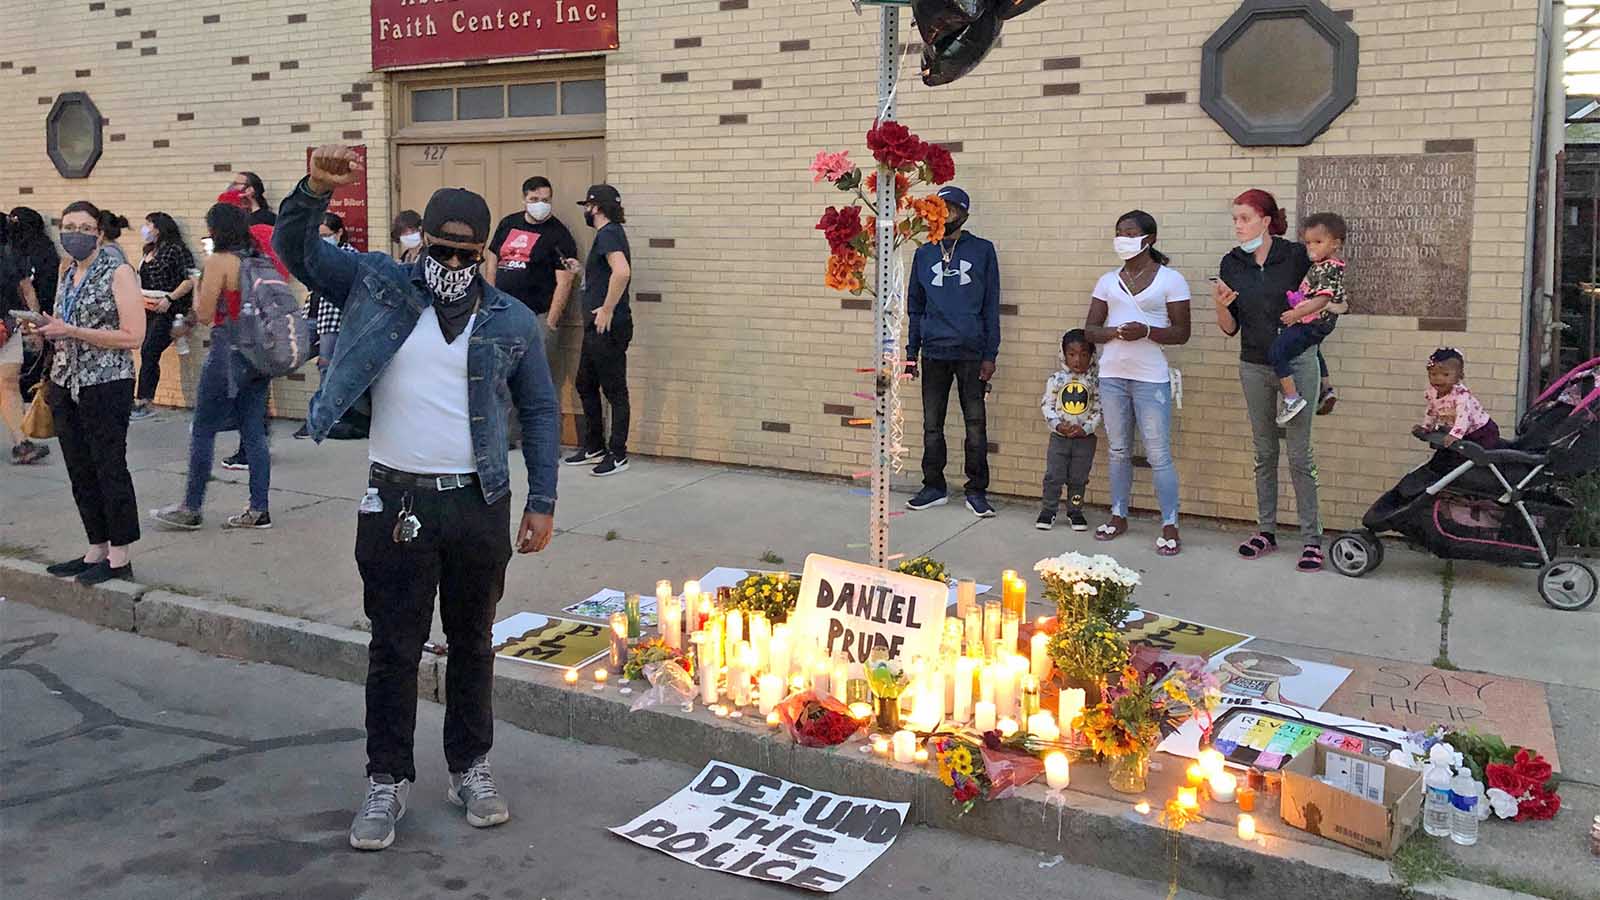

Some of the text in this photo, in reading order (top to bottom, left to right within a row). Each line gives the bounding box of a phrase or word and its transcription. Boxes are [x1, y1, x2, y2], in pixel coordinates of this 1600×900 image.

[379, 1, 607, 40] Faith Center, Inc.
[423, 146, 447, 161] 427
[1350, 162, 1389, 177] HOUSE
[1400, 162, 1416, 175] OF
[1424, 161, 1454, 175] GOD
[1305, 192, 1320, 204] OF
[1306, 178, 1348, 191] WHICH
[1380, 177, 1402, 190] THE
[1414, 175, 1467, 190] CHURCH
[1447, 204, 1465, 217] OF
[816, 578, 922, 629] DANIEL
[1373, 666, 1495, 699] SAY
[692, 764, 901, 843] DEFUND
[709, 806, 836, 859] THE
[627, 819, 846, 890] POLICE
